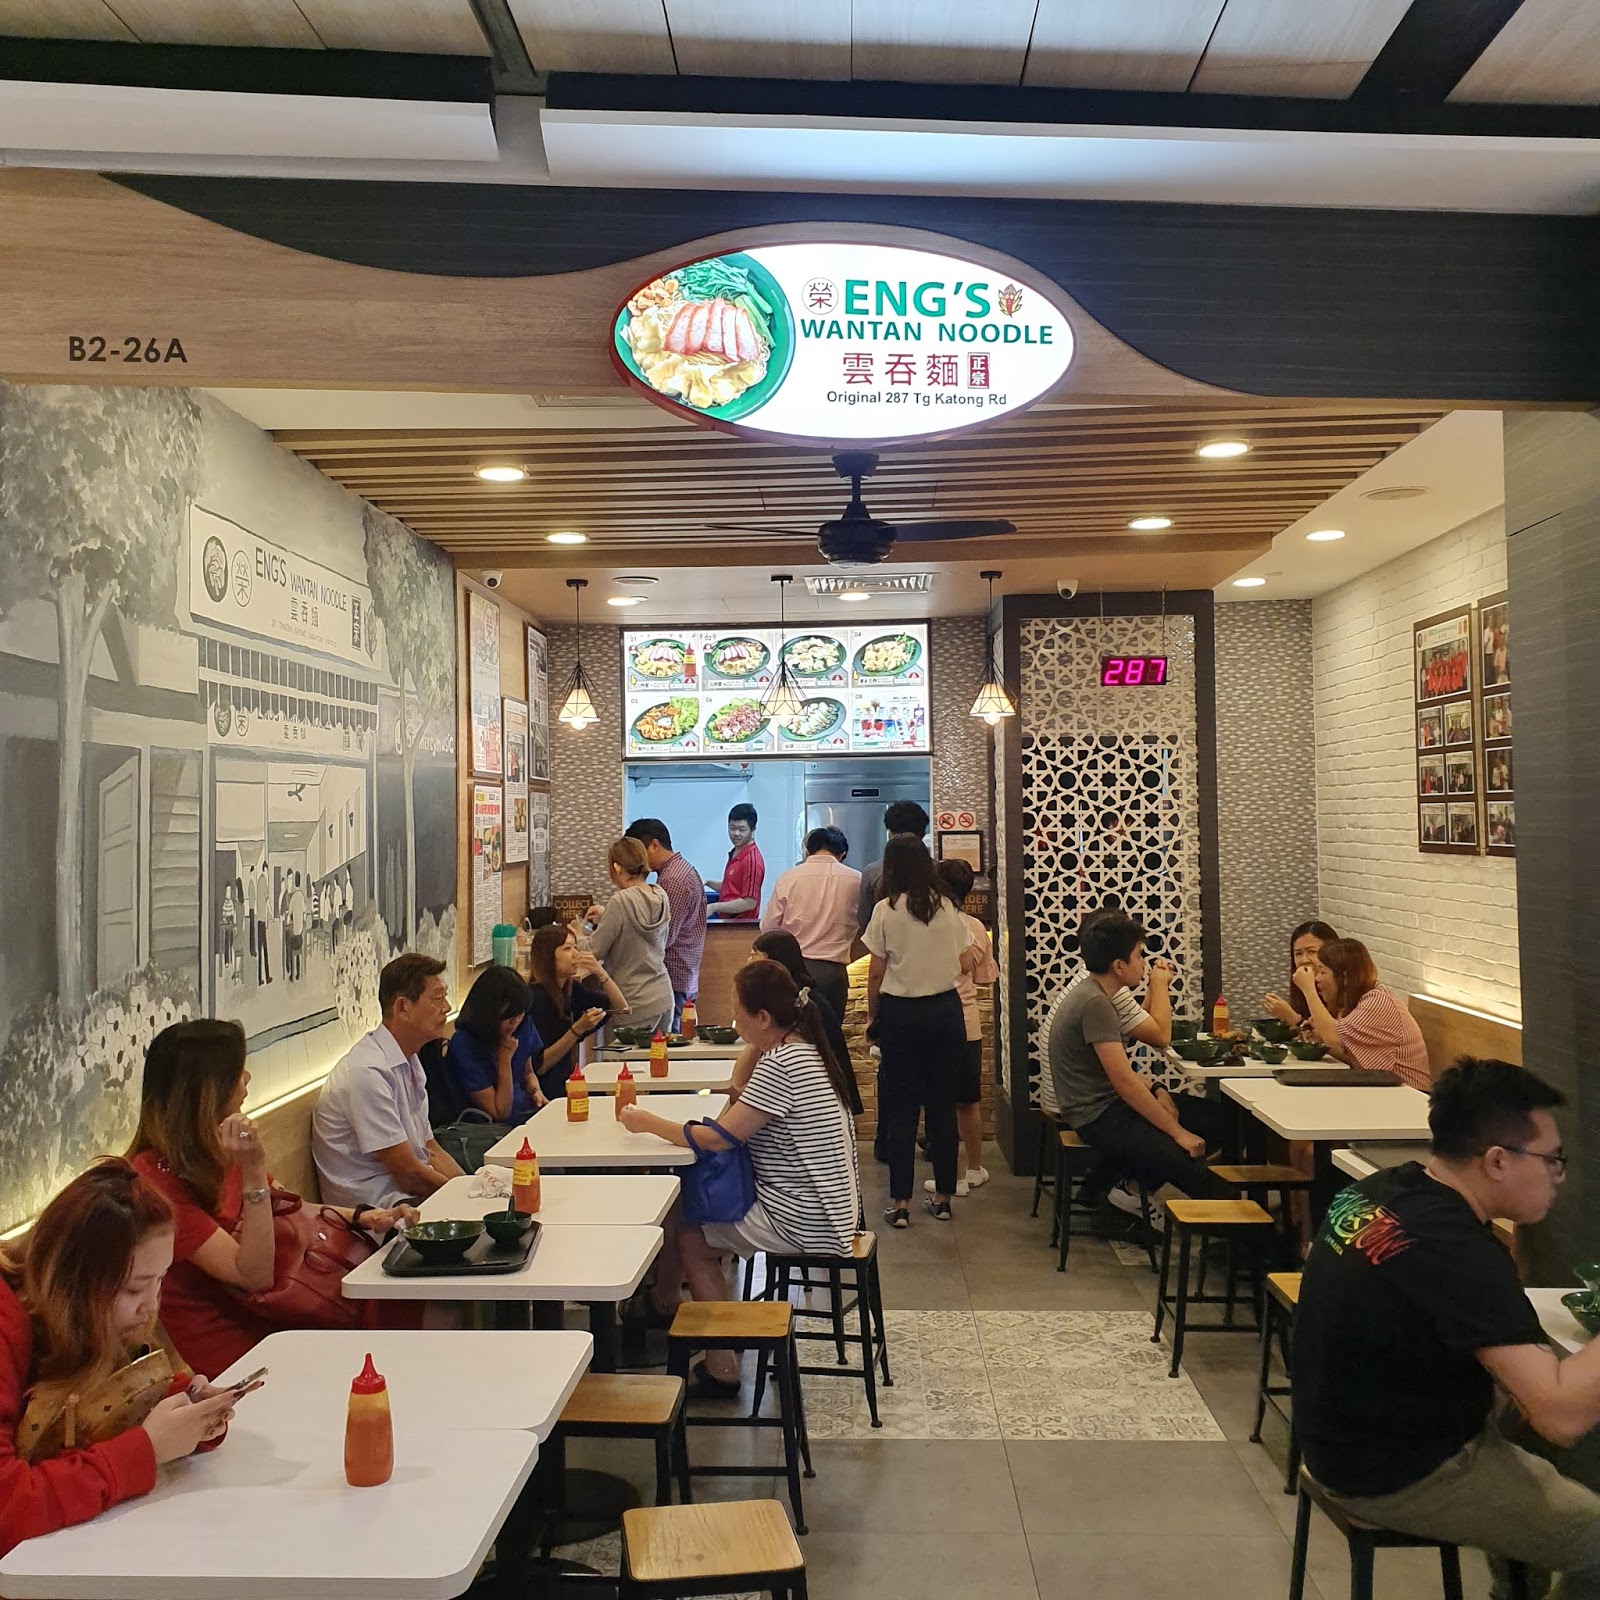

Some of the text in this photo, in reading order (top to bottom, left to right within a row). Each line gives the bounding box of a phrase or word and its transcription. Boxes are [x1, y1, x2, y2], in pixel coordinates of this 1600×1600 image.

[808, 281, 833, 309] 榮
[844, 279, 991, 319] ENG'S
[800, 319, 1053, 345] WANTAN NOODLE
[69, 335, 188, 363] B2-26A
[842, 352, 959, 388] 雲吞麵
[970, 355, 988, 387] 正宗
[826, 390, 1007, 407] Original 287 Tg Katong Rd
[290, 571, 318, 601] WANTAN
[320, 584, 347, 612] NOODLE
[1104, 659, 1166, 684] 287
[554, 900, 590, 910] COLLECT
[961, 904, 983, 914] ERE
